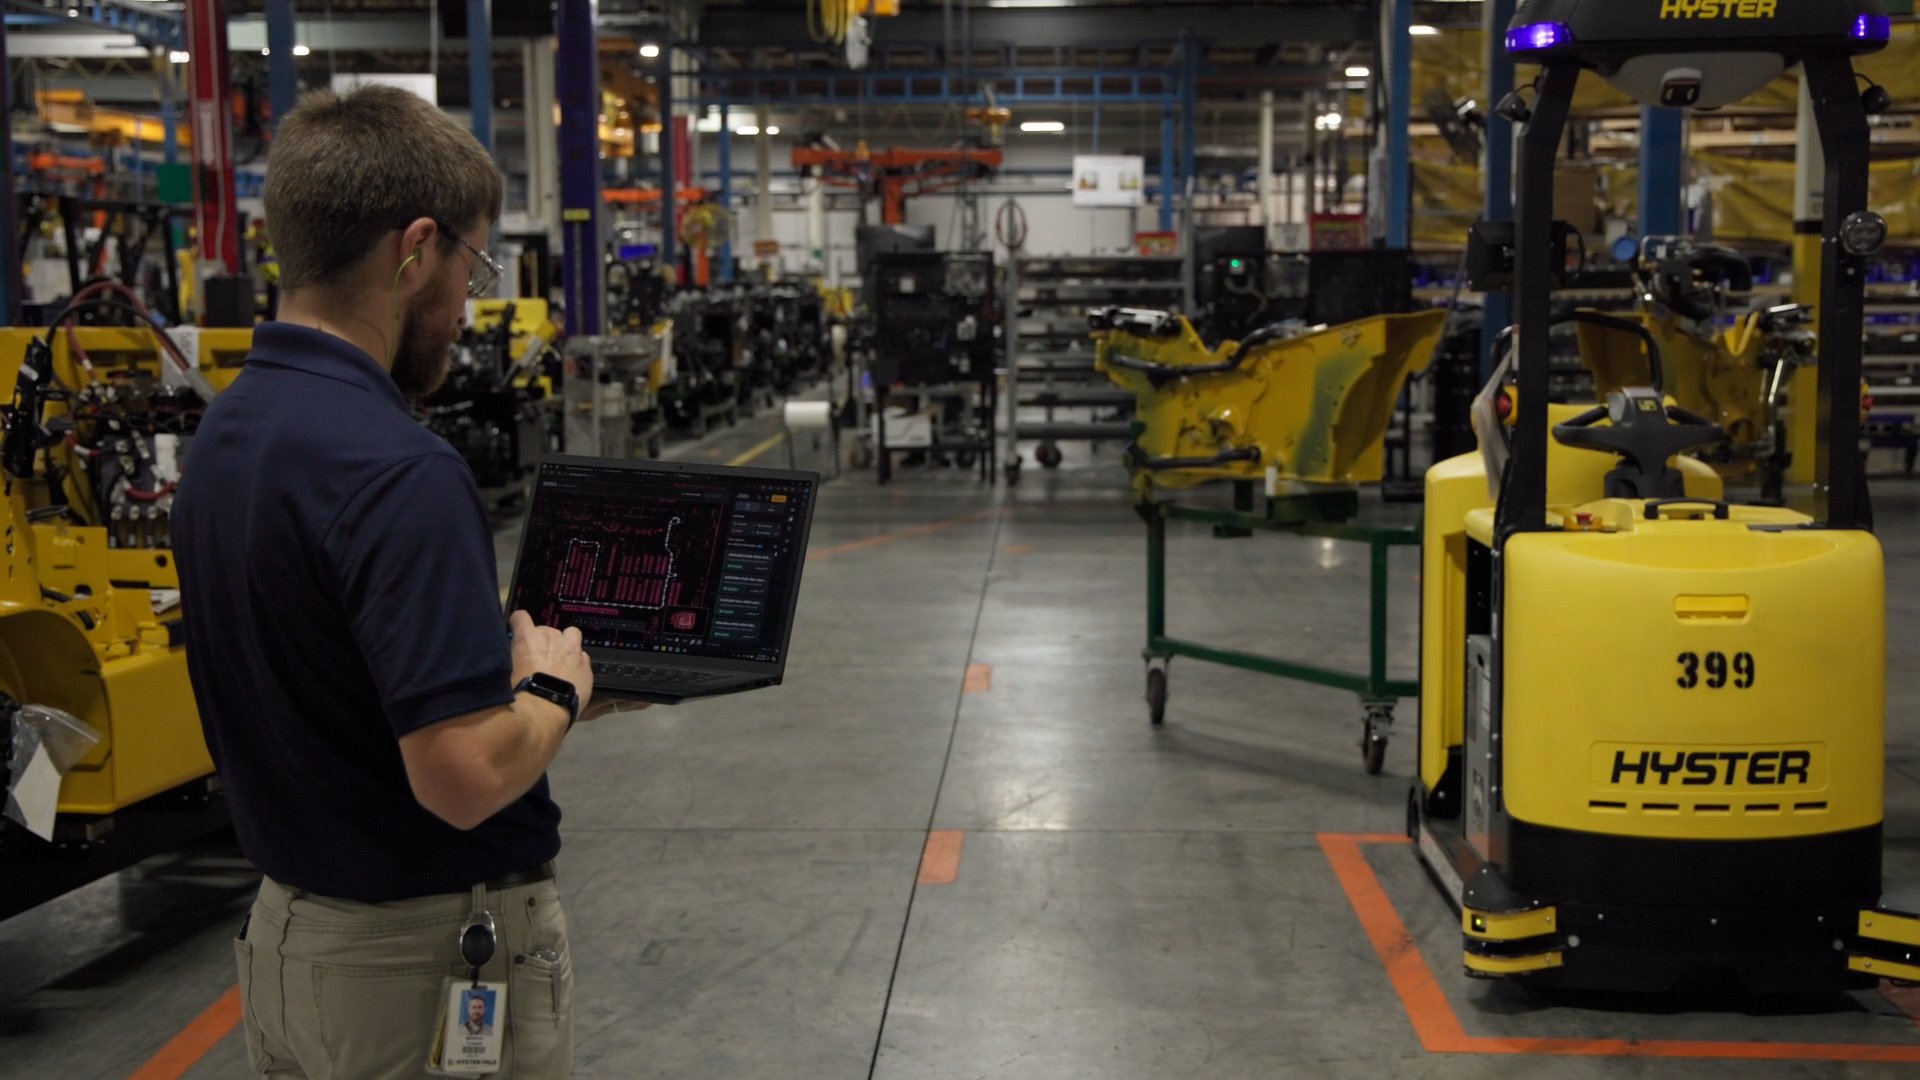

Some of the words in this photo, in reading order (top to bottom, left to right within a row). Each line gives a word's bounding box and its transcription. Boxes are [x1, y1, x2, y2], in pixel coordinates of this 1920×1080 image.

[1659, 0, 1778, 19] HYSTER
[1676, 651, 1756, 689] 399
[1610, 750, 1811, 785] HYSTER
